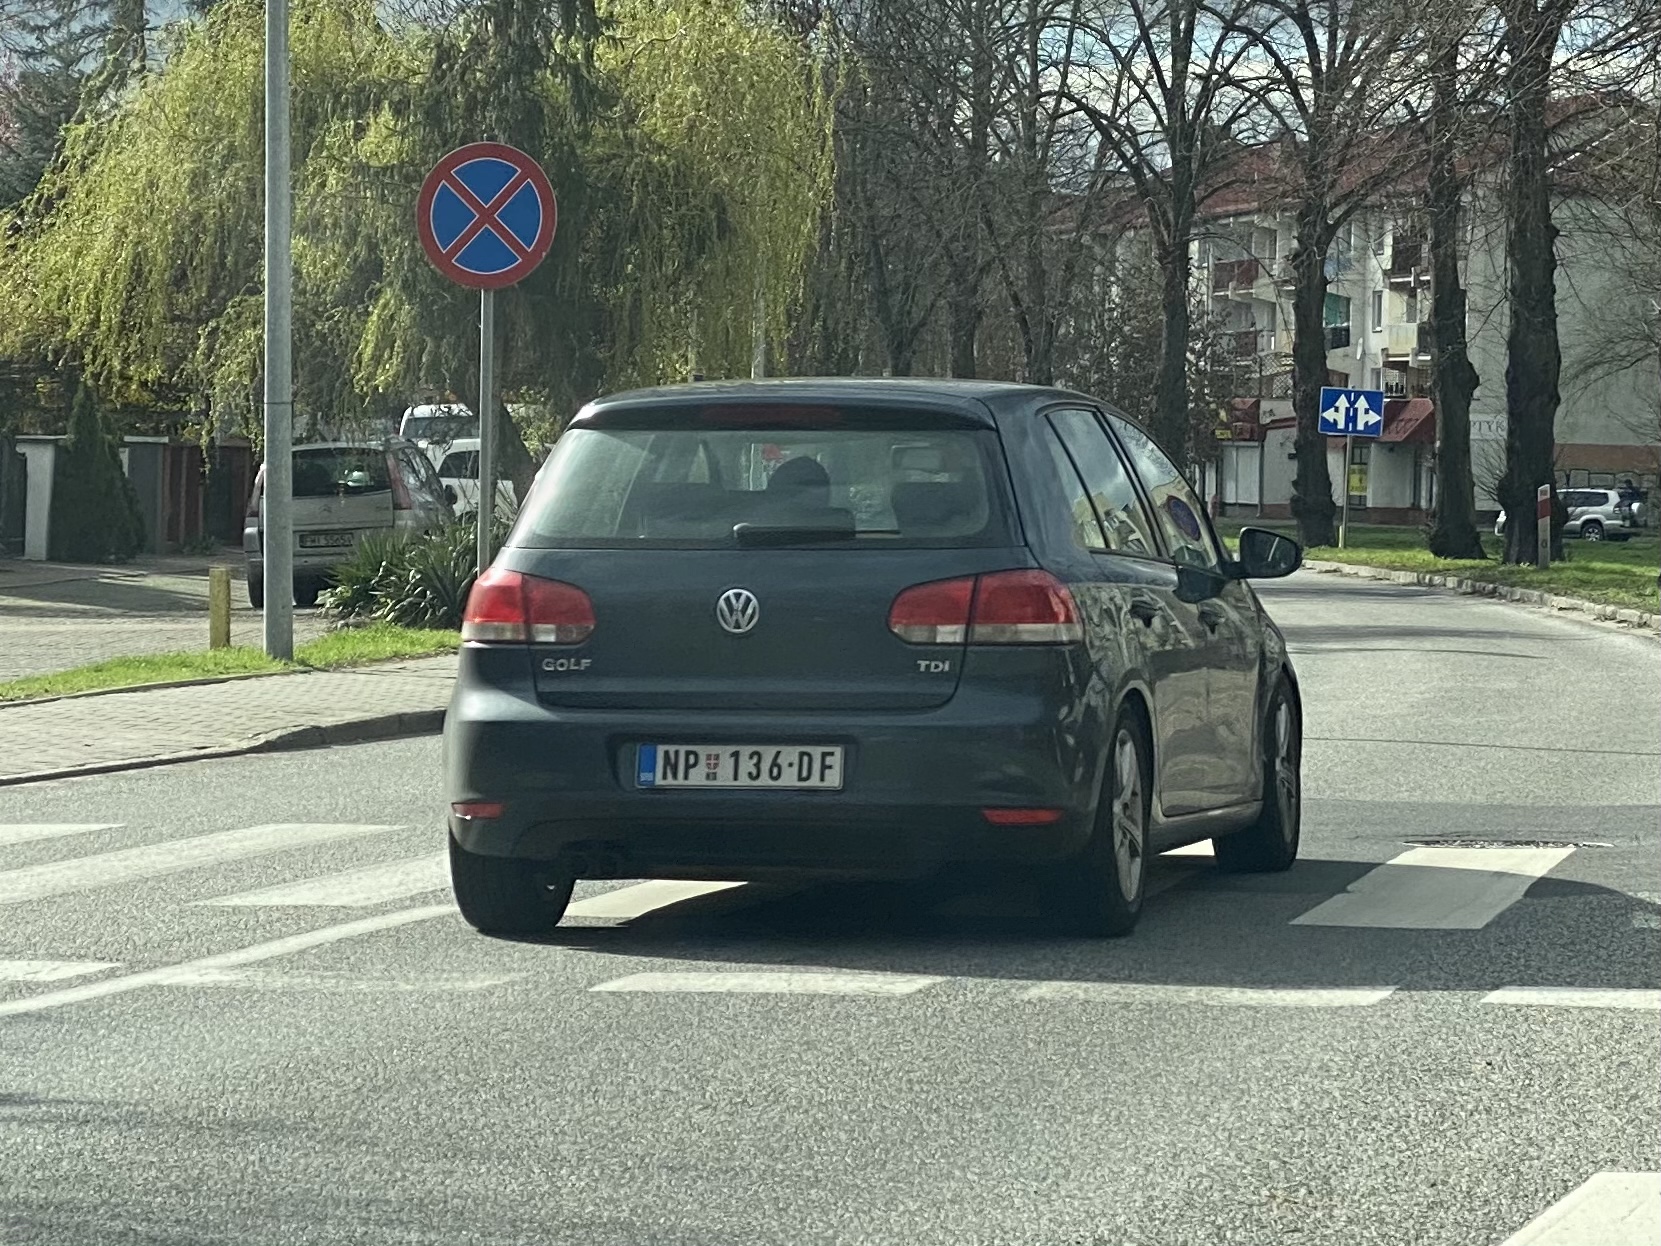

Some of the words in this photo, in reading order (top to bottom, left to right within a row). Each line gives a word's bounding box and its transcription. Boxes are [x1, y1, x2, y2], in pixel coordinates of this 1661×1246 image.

[717, 588, 759, 634] VW
[542, 658, 592, 671] GOLF
[917, 660, 950, 672] TDI
[662, 749, 699, 780] NP
